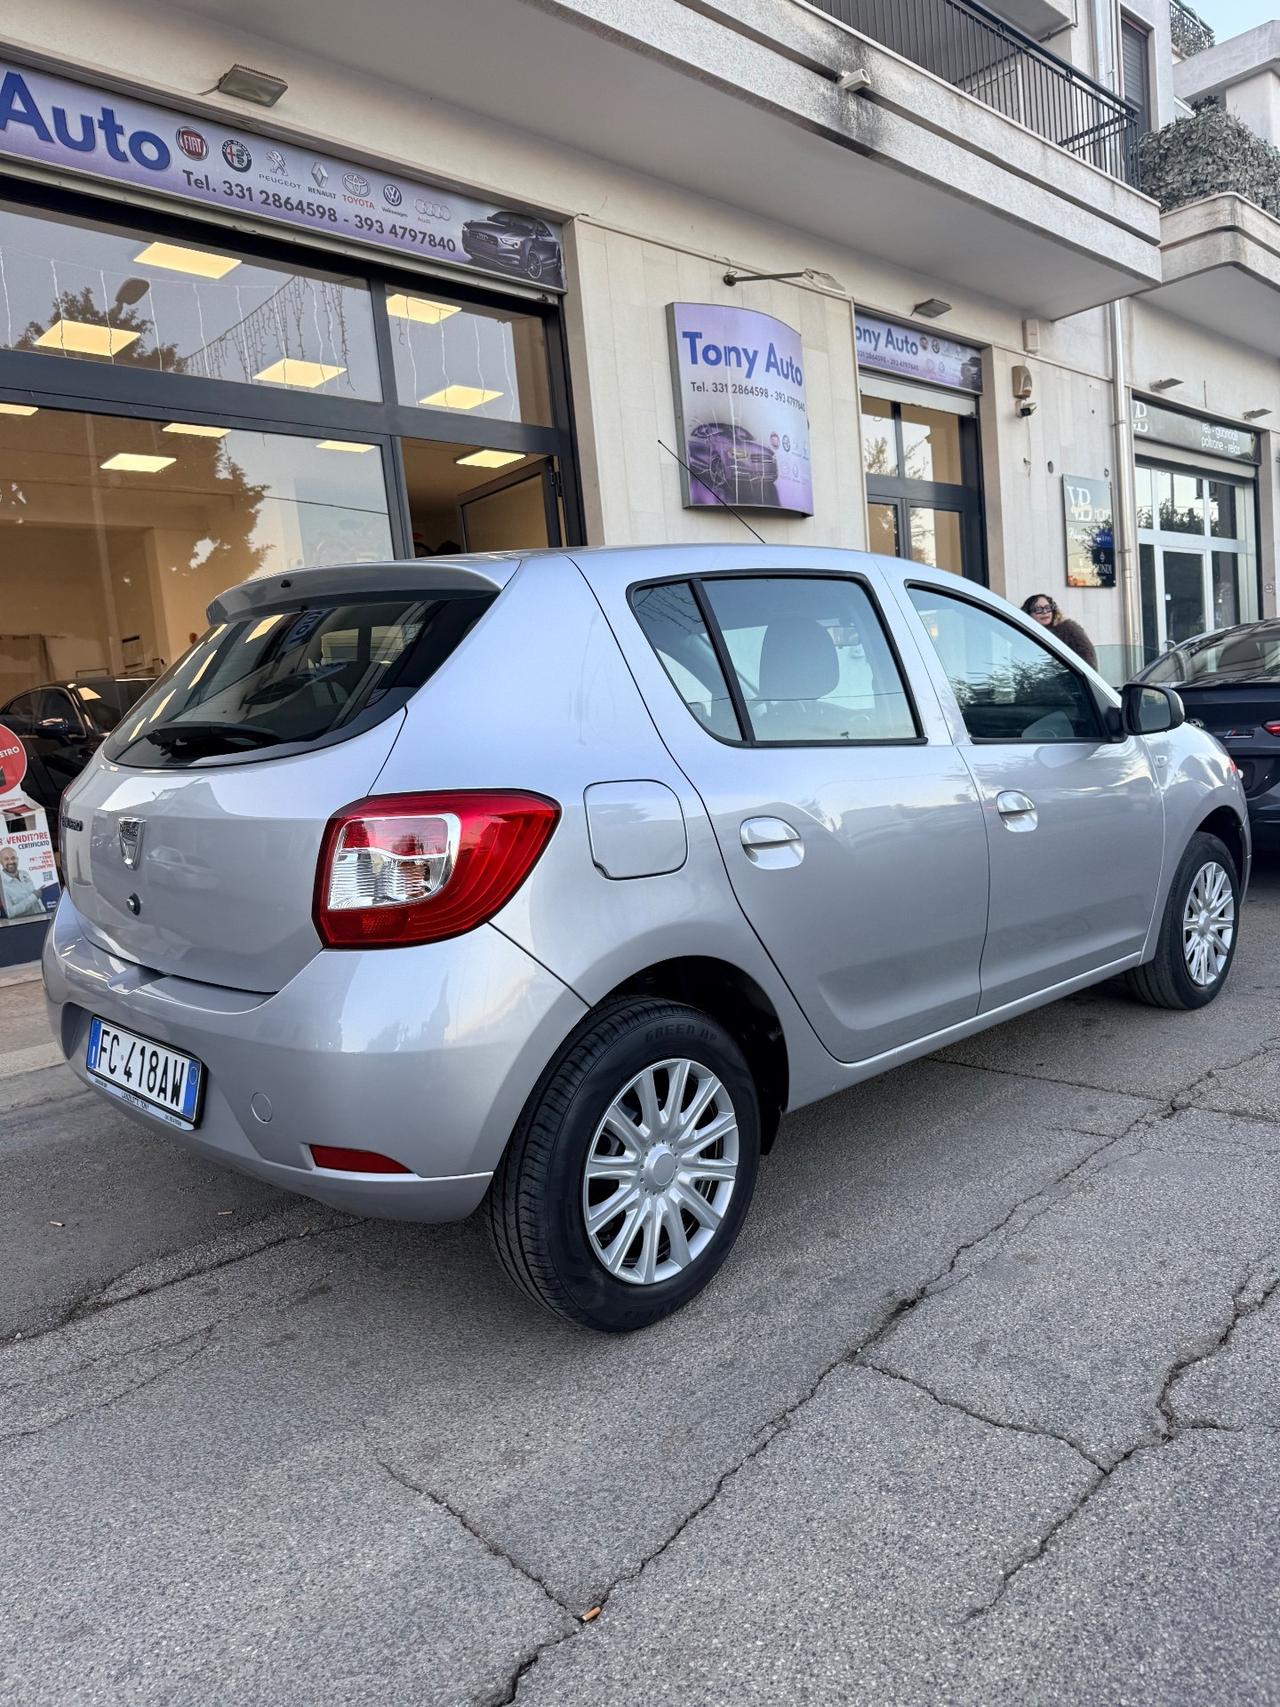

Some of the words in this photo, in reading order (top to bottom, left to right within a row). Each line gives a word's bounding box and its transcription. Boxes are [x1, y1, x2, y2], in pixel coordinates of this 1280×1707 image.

[0, 71, 171, 171] Auto
[183, 135, 202, 153] FIAT
[258, 173, 301, 190] PEUGEOT
[307, 186, 337, 200] RENAULT
[342, 194, 376, 210] TOYOTA
[182, 169, 217, 193] Tel.
[222, 180, 254, 202] 331
[259, 190, 338, 223] 2864598
[354, 214, 384, 235] 393
[388, 223, 456, 253] 4797840
[855, 325, 881, 351] ony
[885, 328, 919, 355] Auto
[682, 331, 759, 379] Tony
[765, 342, 803, 387] Auto
[690, 381, 709, 393] Tel.
[711, 382, 729, 394] 331
[732, 383, 769, 399] 2864598
[0, 746, 20, 758] ETRO
[7, 832, 49, 845] VENDITORE
[18, 840, 49, 850] CERTIFICATO
[98, 1028, 120, 1075] FC
[123, 1041, 185, 1107] 418AW
